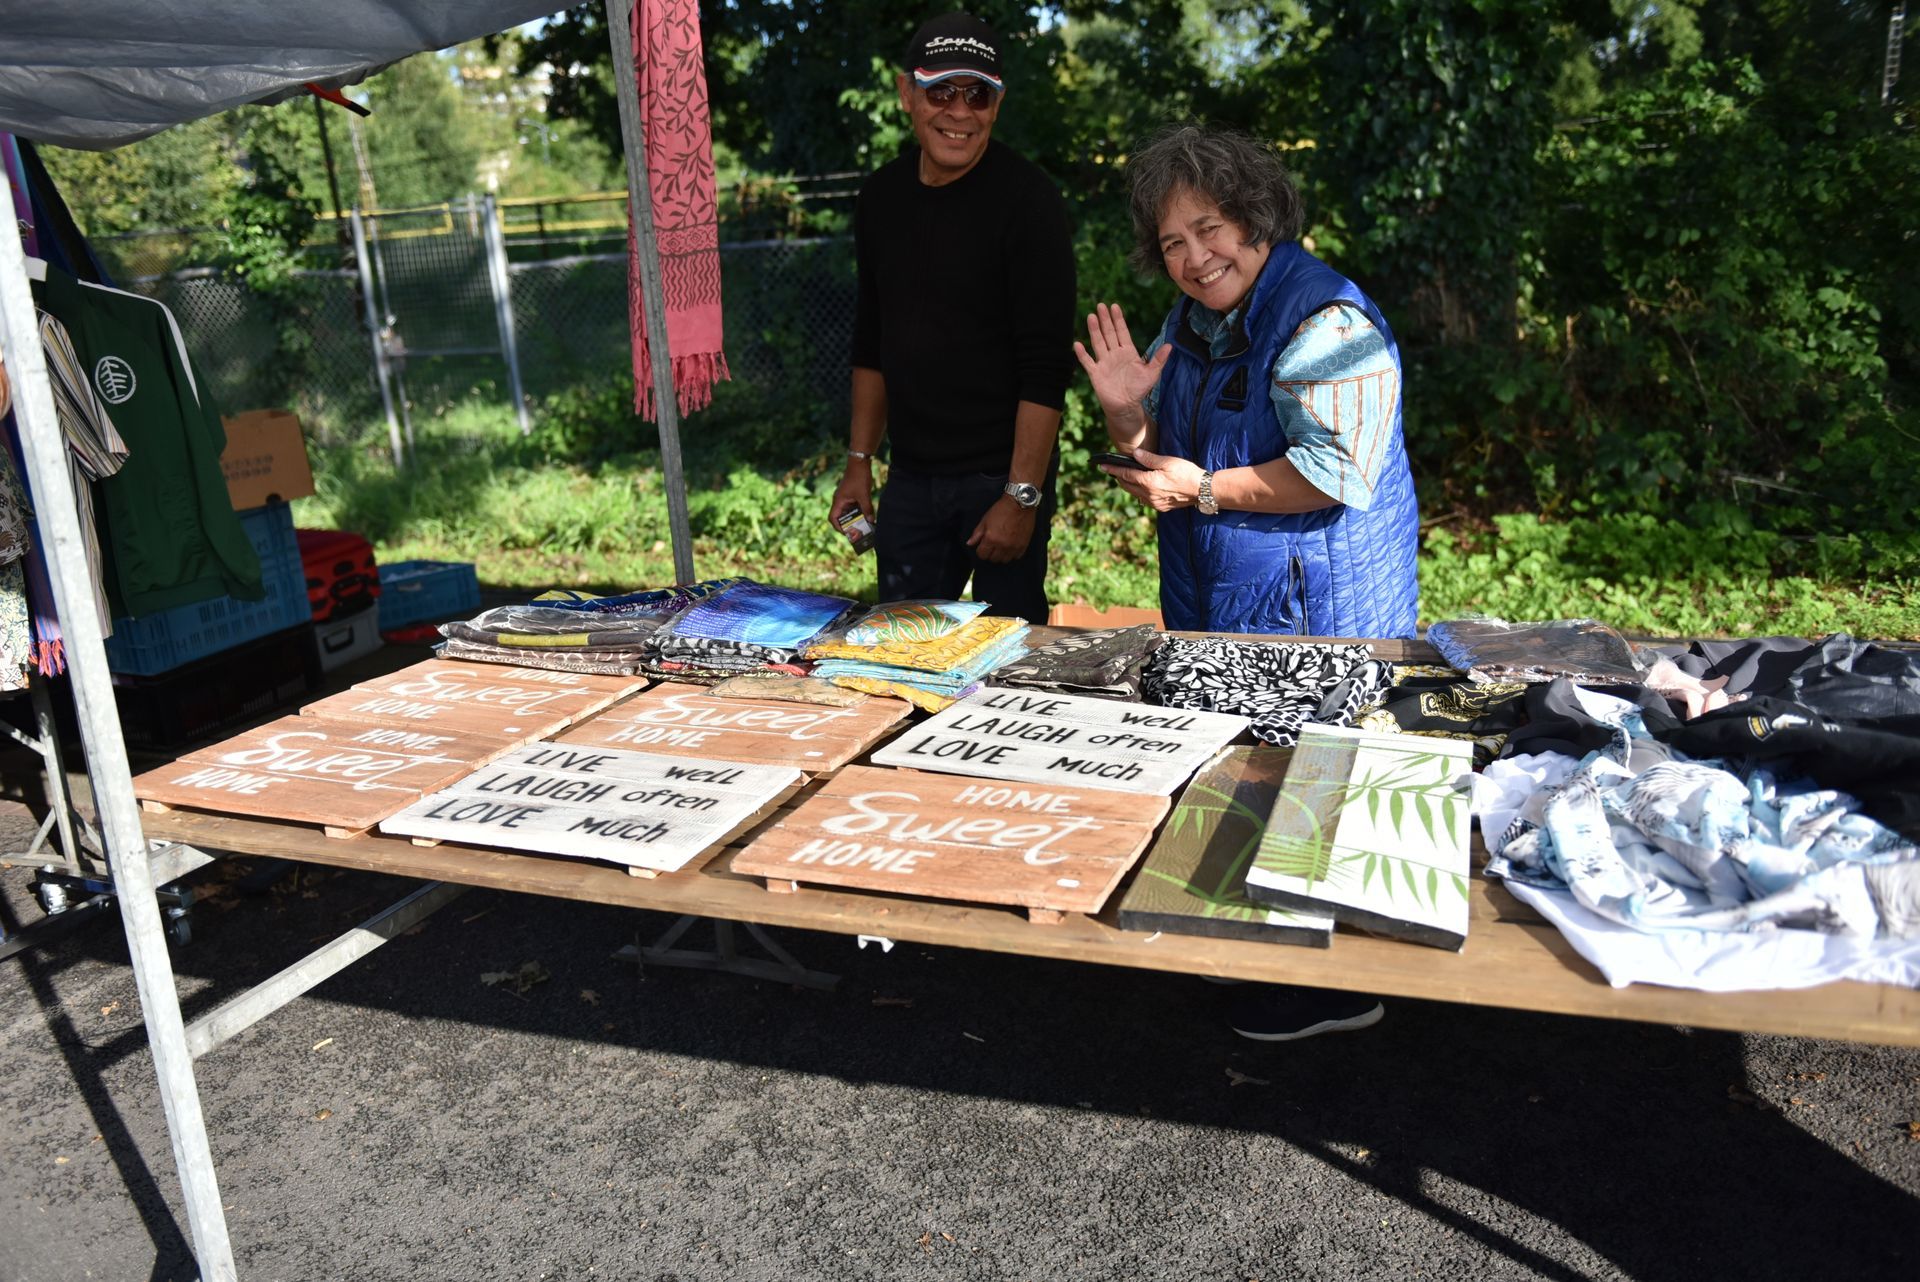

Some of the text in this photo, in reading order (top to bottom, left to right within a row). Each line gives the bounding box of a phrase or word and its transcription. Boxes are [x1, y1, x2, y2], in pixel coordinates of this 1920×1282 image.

[926, 46, 959, 56] FORMULA
[500, 667, 592, 684] HOME
[350, 698, 456, 719] HOME
[389, 670, 589, 716] Sweet
[633, 693, 859, 740] Sweet
[982, 694, 1197, 730] LIVE well
[352, 728, 456, 750] HOME
[605, 726, 722, 747] HOME
[948, 715, 1182, 753] LAUGH often
[221, 732, 449, 791] Sweet
[908, 736, 1018, 765] LOVE
[170, 768, 290, 794] HOME
[523, 749, 745, 785] LIVE well
[476, 773, 719, 811] LAUGH often
[952, 785, 1082, 813] HOME
[424, 799, 543, 828] LOVE
[821, 791, 1104, 865] Sweet
[788, 839, 936, 873] HOME
